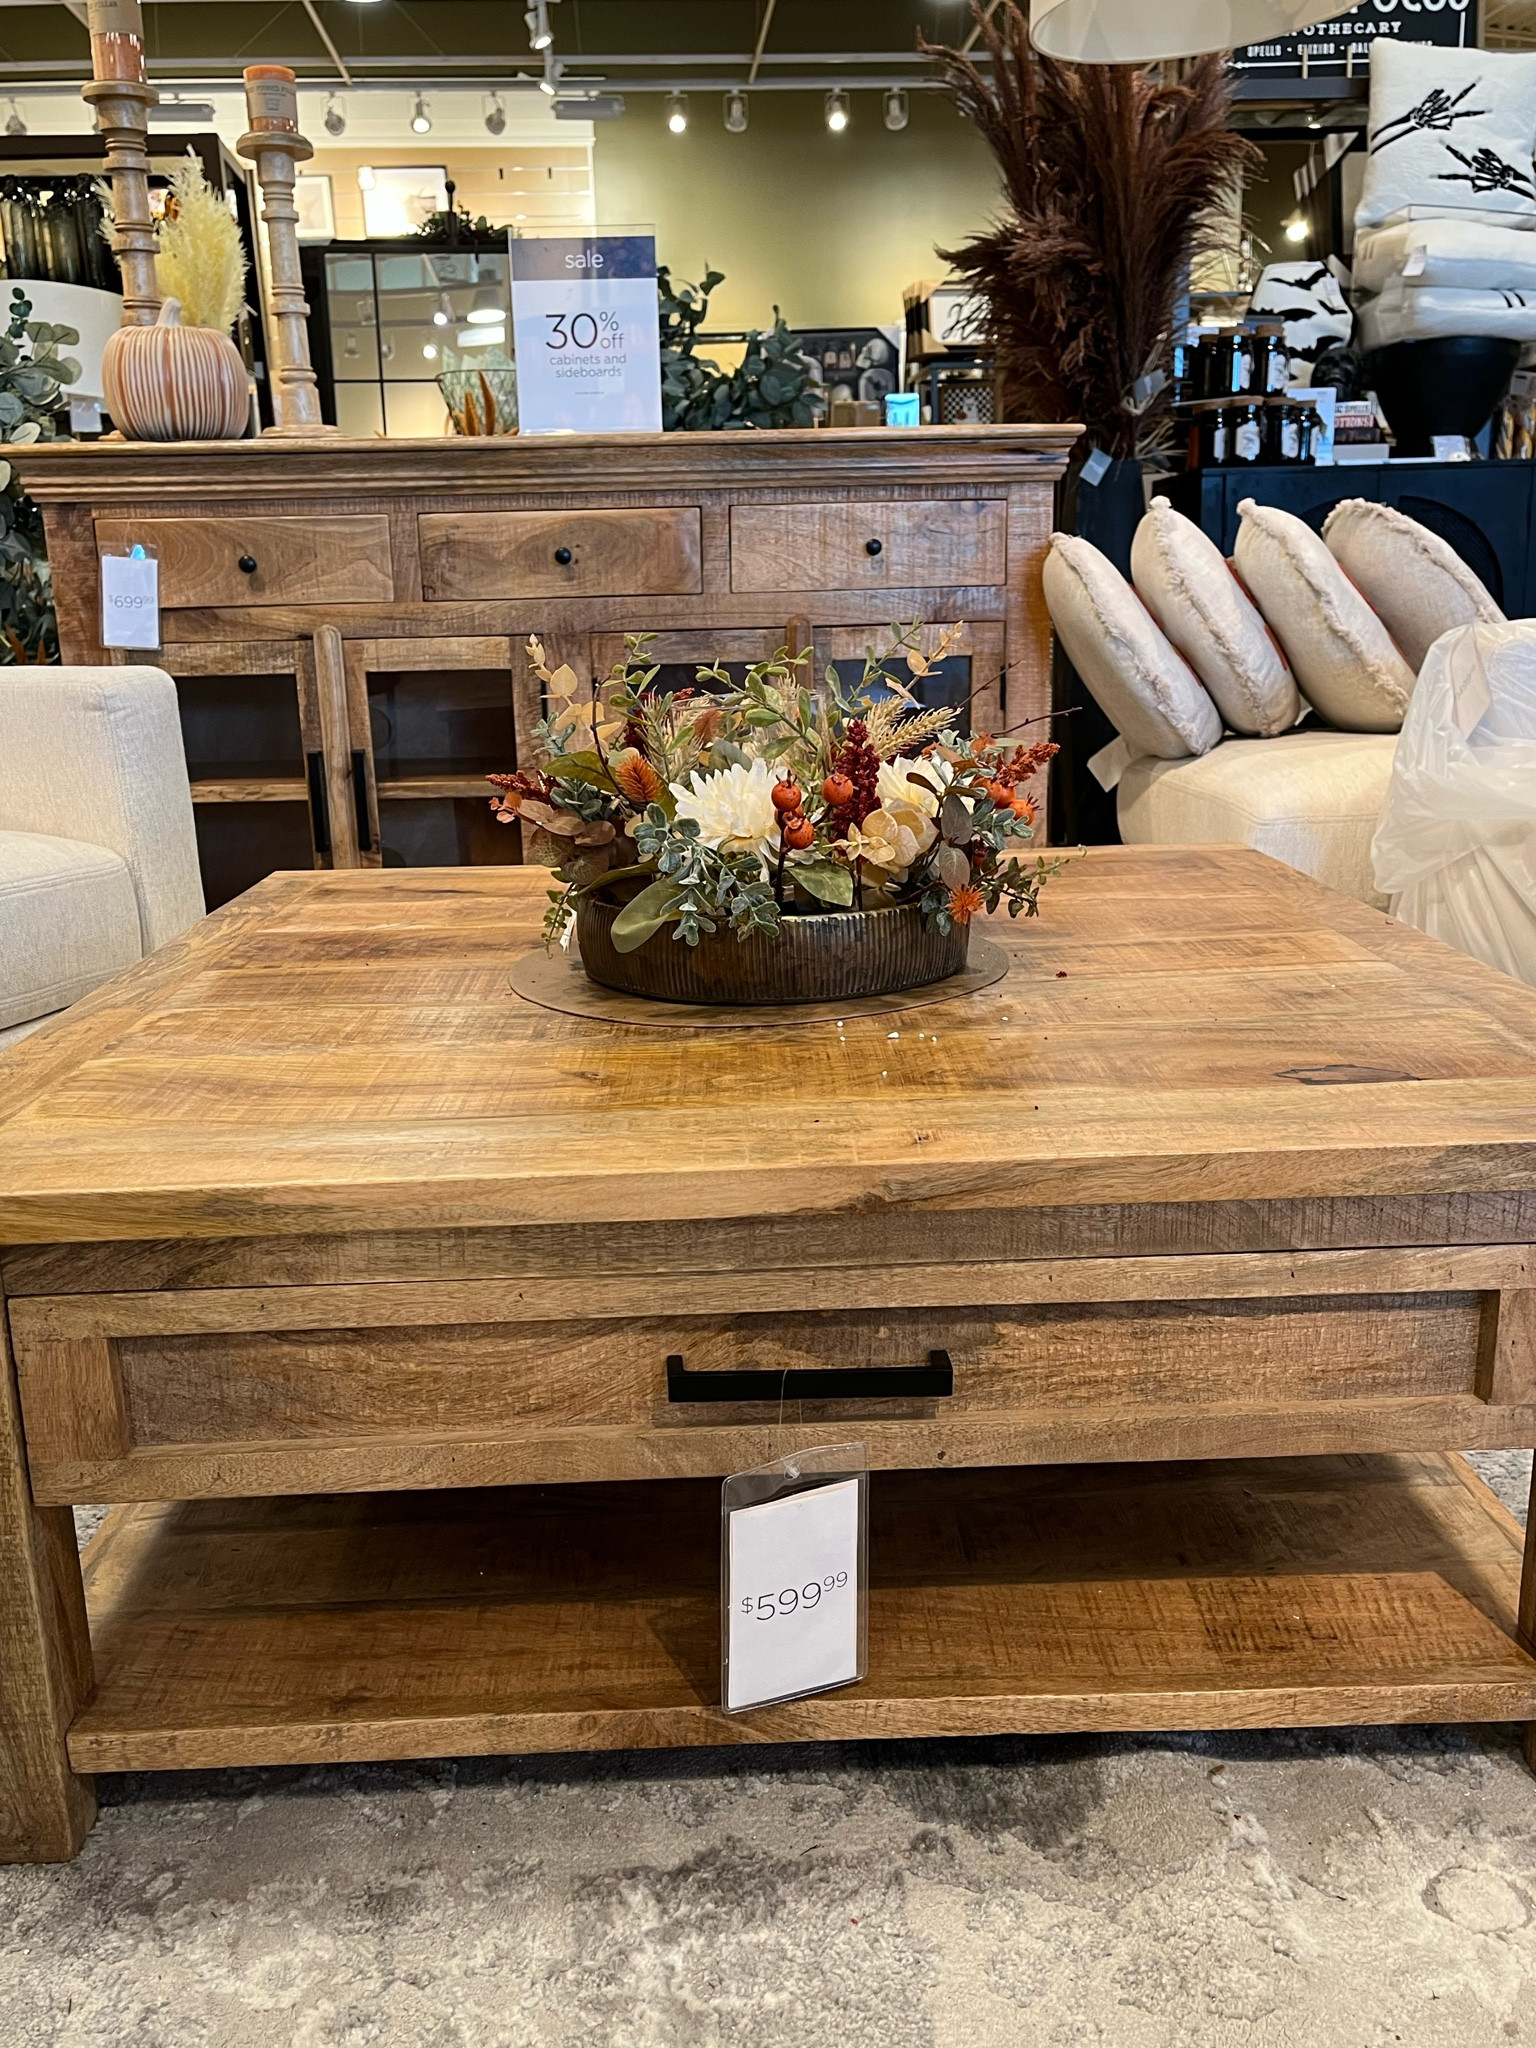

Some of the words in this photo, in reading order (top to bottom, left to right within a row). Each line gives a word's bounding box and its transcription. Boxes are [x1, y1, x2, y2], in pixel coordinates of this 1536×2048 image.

[1285, 21, 1402, 37] OTHECARY
[564, 249, 604, 269] sale
[600, 332, 625, 349] off
[549, 354, 601, 366] cabinets
[603, 353, 627, 365] and
[555, 366, 622, 378] sideboards
